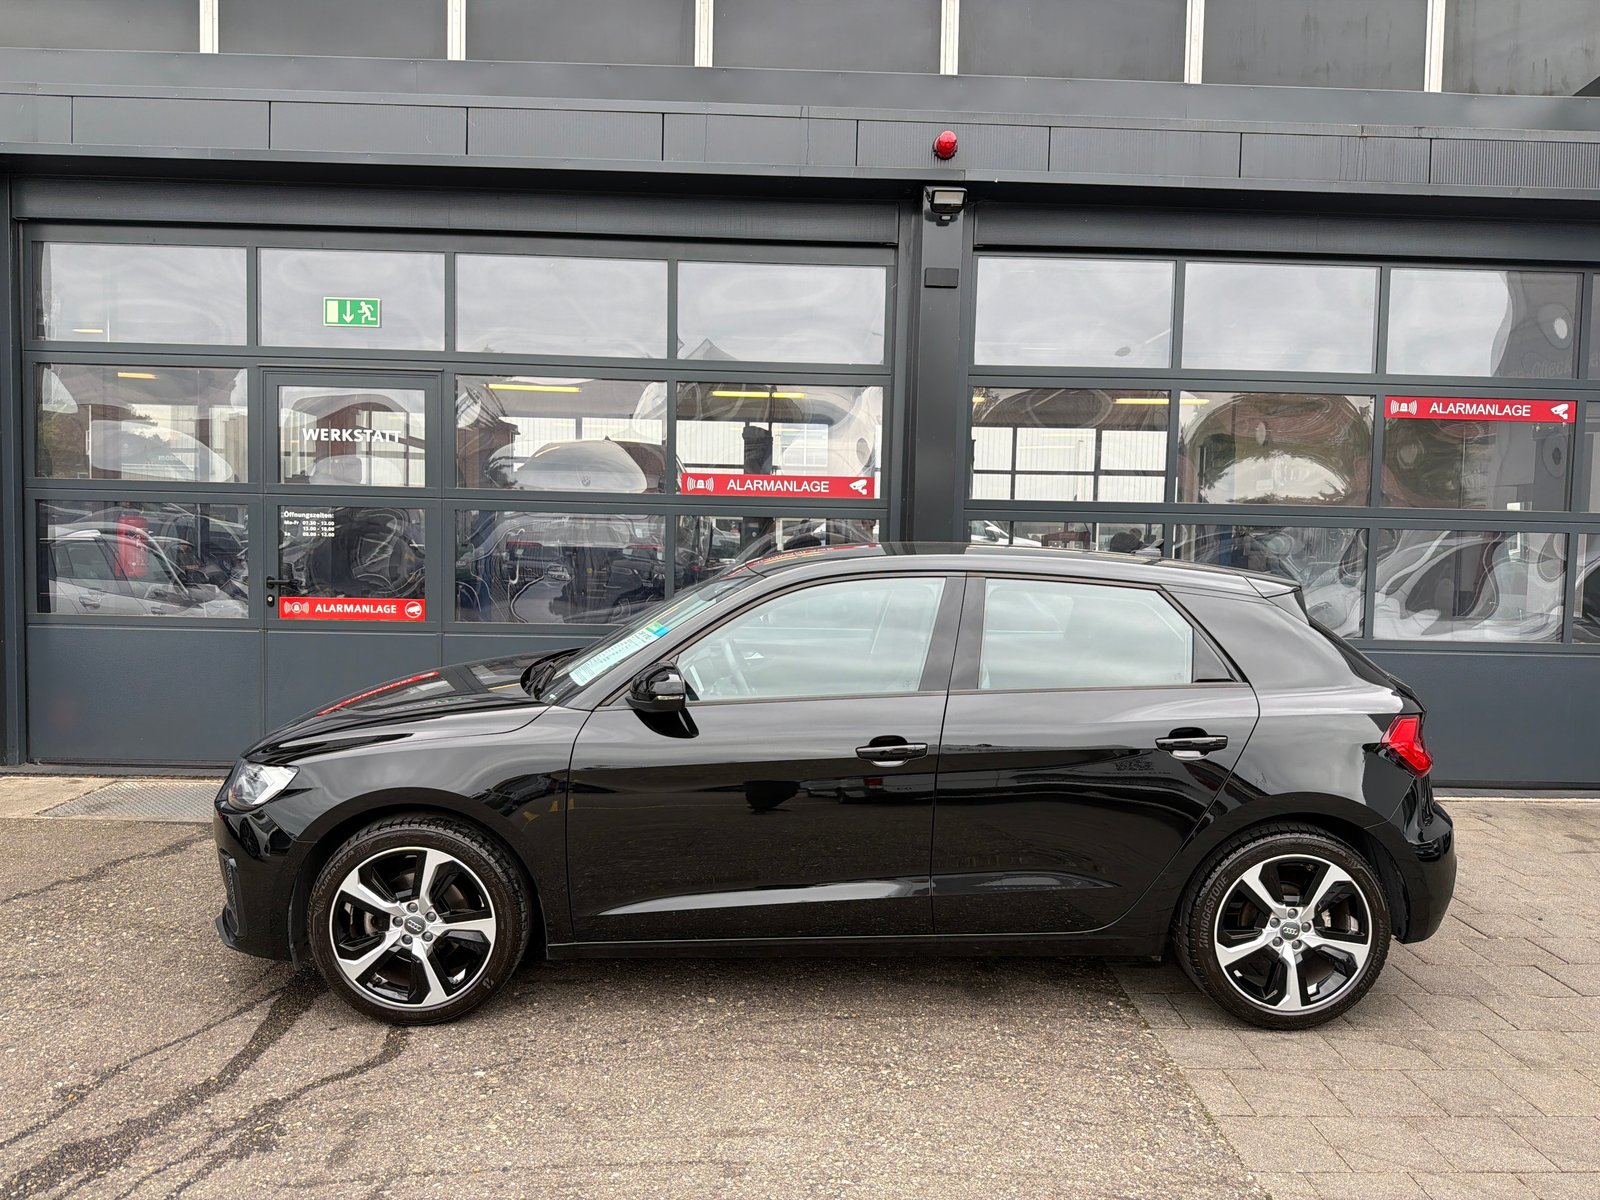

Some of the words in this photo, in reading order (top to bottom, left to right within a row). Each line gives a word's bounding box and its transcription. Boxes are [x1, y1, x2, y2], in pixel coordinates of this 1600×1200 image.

[1429, 402, 1531, 417] ALARMANLAGE
[302, 428, 401, 443] WERKSTATT
[726, 479, 830, 493] ALARMANLAGE
[314, 603, 398, 614] ALARMANLAGE
[1198, 874, 1229, 949] BRIDGESTONE
